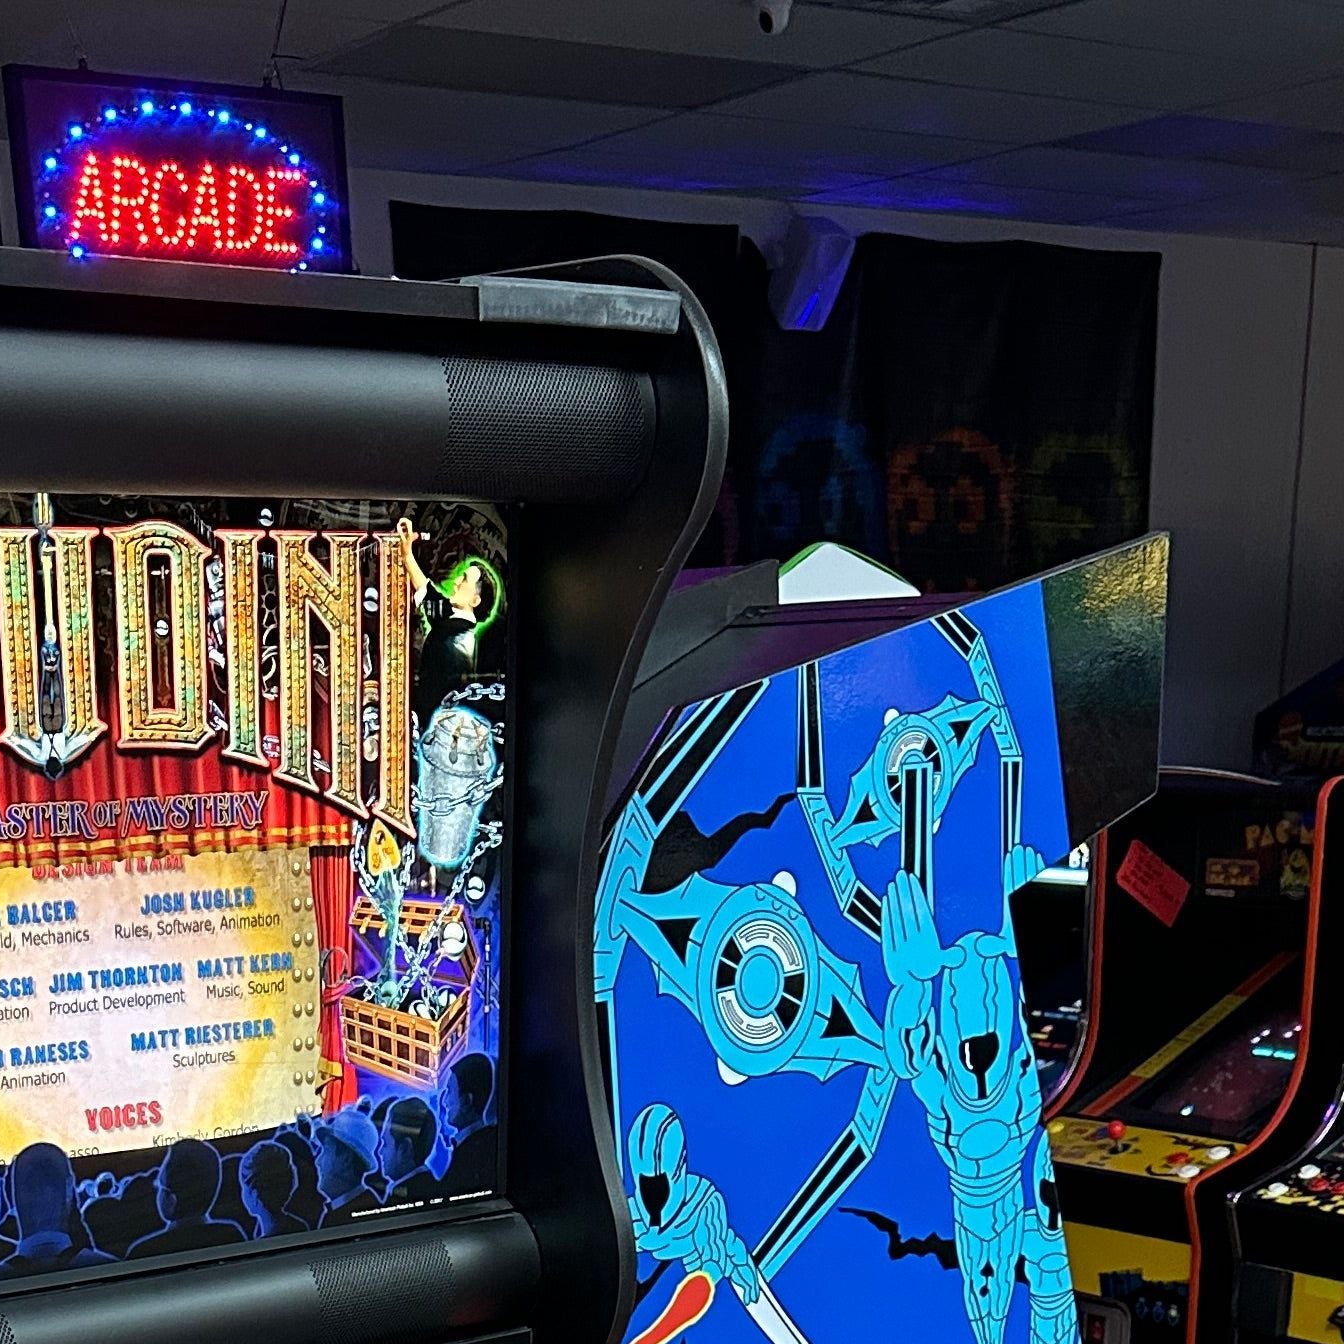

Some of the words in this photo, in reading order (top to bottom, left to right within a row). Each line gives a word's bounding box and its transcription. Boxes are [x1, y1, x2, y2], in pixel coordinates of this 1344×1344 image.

[68, 152, 307, 255] ARCADE
[94, 801, 121, 828] OF
[121, 791, 269, 837] MYSTERY
[7, 900, 78, 926] BALCER
[140, 891, 186, 916] JOSH
[189, 886, 256, 911] KUGLER
[21, 928, 90, 948] Mechanics
[114, 921, 153, 941] Rules,
[156, 915, 215, 938] Software,
[219, 913, 280, 931] Animation
[49, 968, 84, 994] JIM
[87, 962, 184, 989] THORNTON
[197, 956, 245, 981] MATT
[249, 952, 294, 975] KERN
[49, 999, 99, 1017] Product
[102, 989, 186, 1012] Development
[206, 982, 244, 1000] Music,
[248, 978, 285, 996] Sound
[130, 1028, 181, 1053] MATT
[184, 1017, 276, 1044] RIESTERER
[9, 1040, 91, 1067] RANESES
[172, 1050, 236, 1070] Sculptures
[0, 1069, 66, 1091] Animation
[84, 1100, 164, 1132] VOICES
